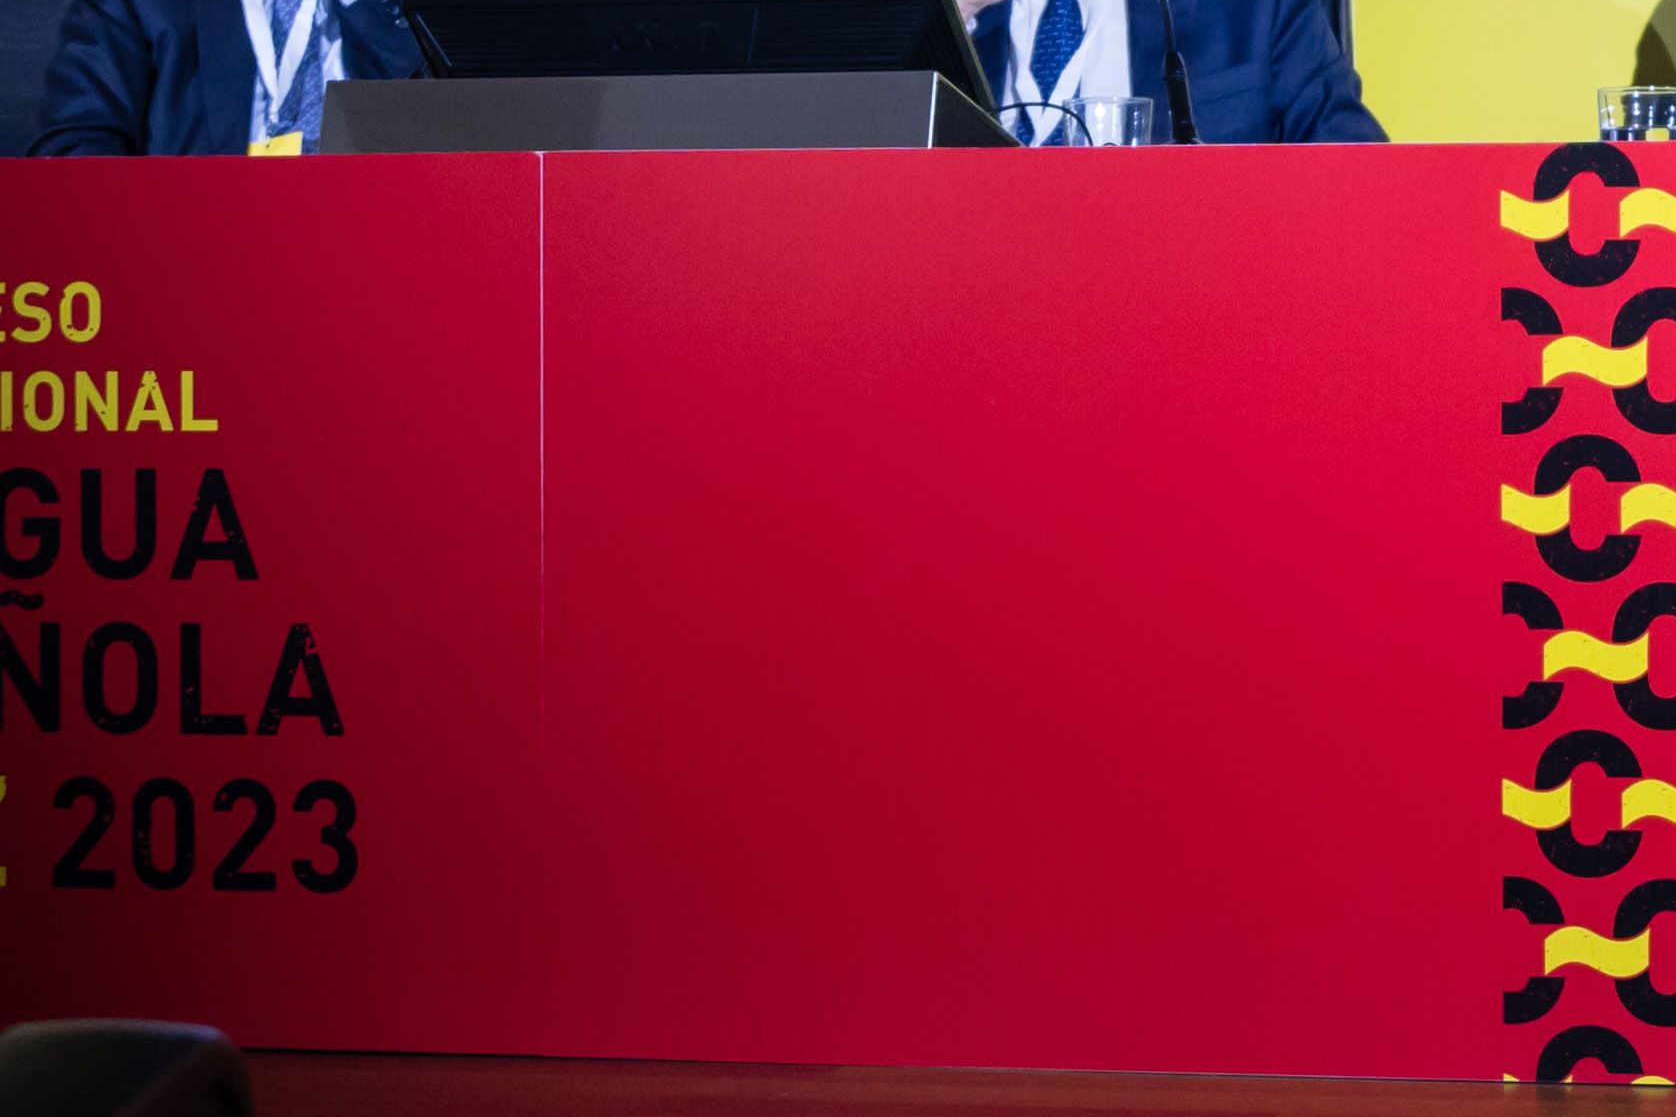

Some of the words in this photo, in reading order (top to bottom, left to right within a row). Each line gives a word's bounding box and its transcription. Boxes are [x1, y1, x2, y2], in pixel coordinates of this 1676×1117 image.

[0, 281, 101, 343] SO
[0, 370, 219, 432] IONAL
[0, 467, 260, 581] GUA
[0, 589, 345, 736] ÑOLA
[51, 776, 359, 895] 2023
